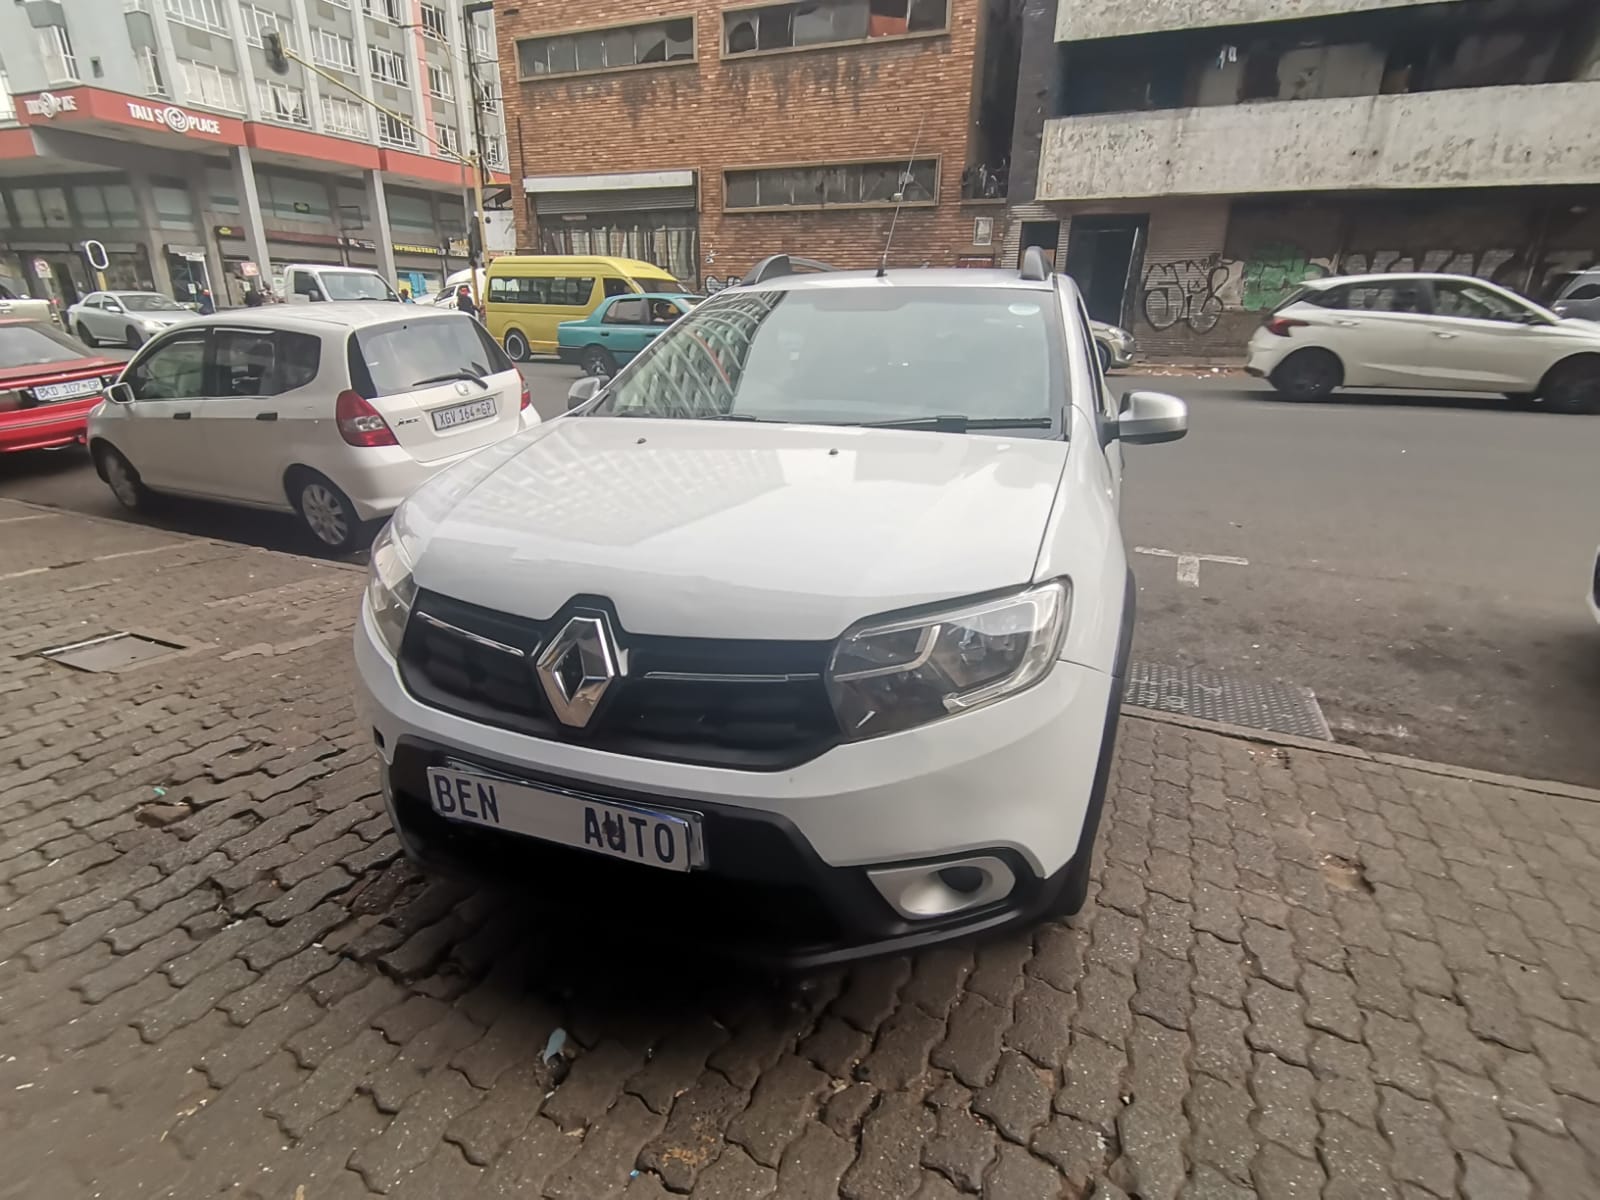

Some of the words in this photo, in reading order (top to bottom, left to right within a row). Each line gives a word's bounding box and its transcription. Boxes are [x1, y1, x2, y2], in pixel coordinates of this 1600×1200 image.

[188, 117, 221, 135] PLACE
[63, 383, 80, 394] 107
[439, 411, 456, 426] XGV
[459, 406, 475, 421] 164
[480, 402, 492, 416] GP
[433, 774, 500, 823] BEN
[584, 806, 675, 864] AUTO
